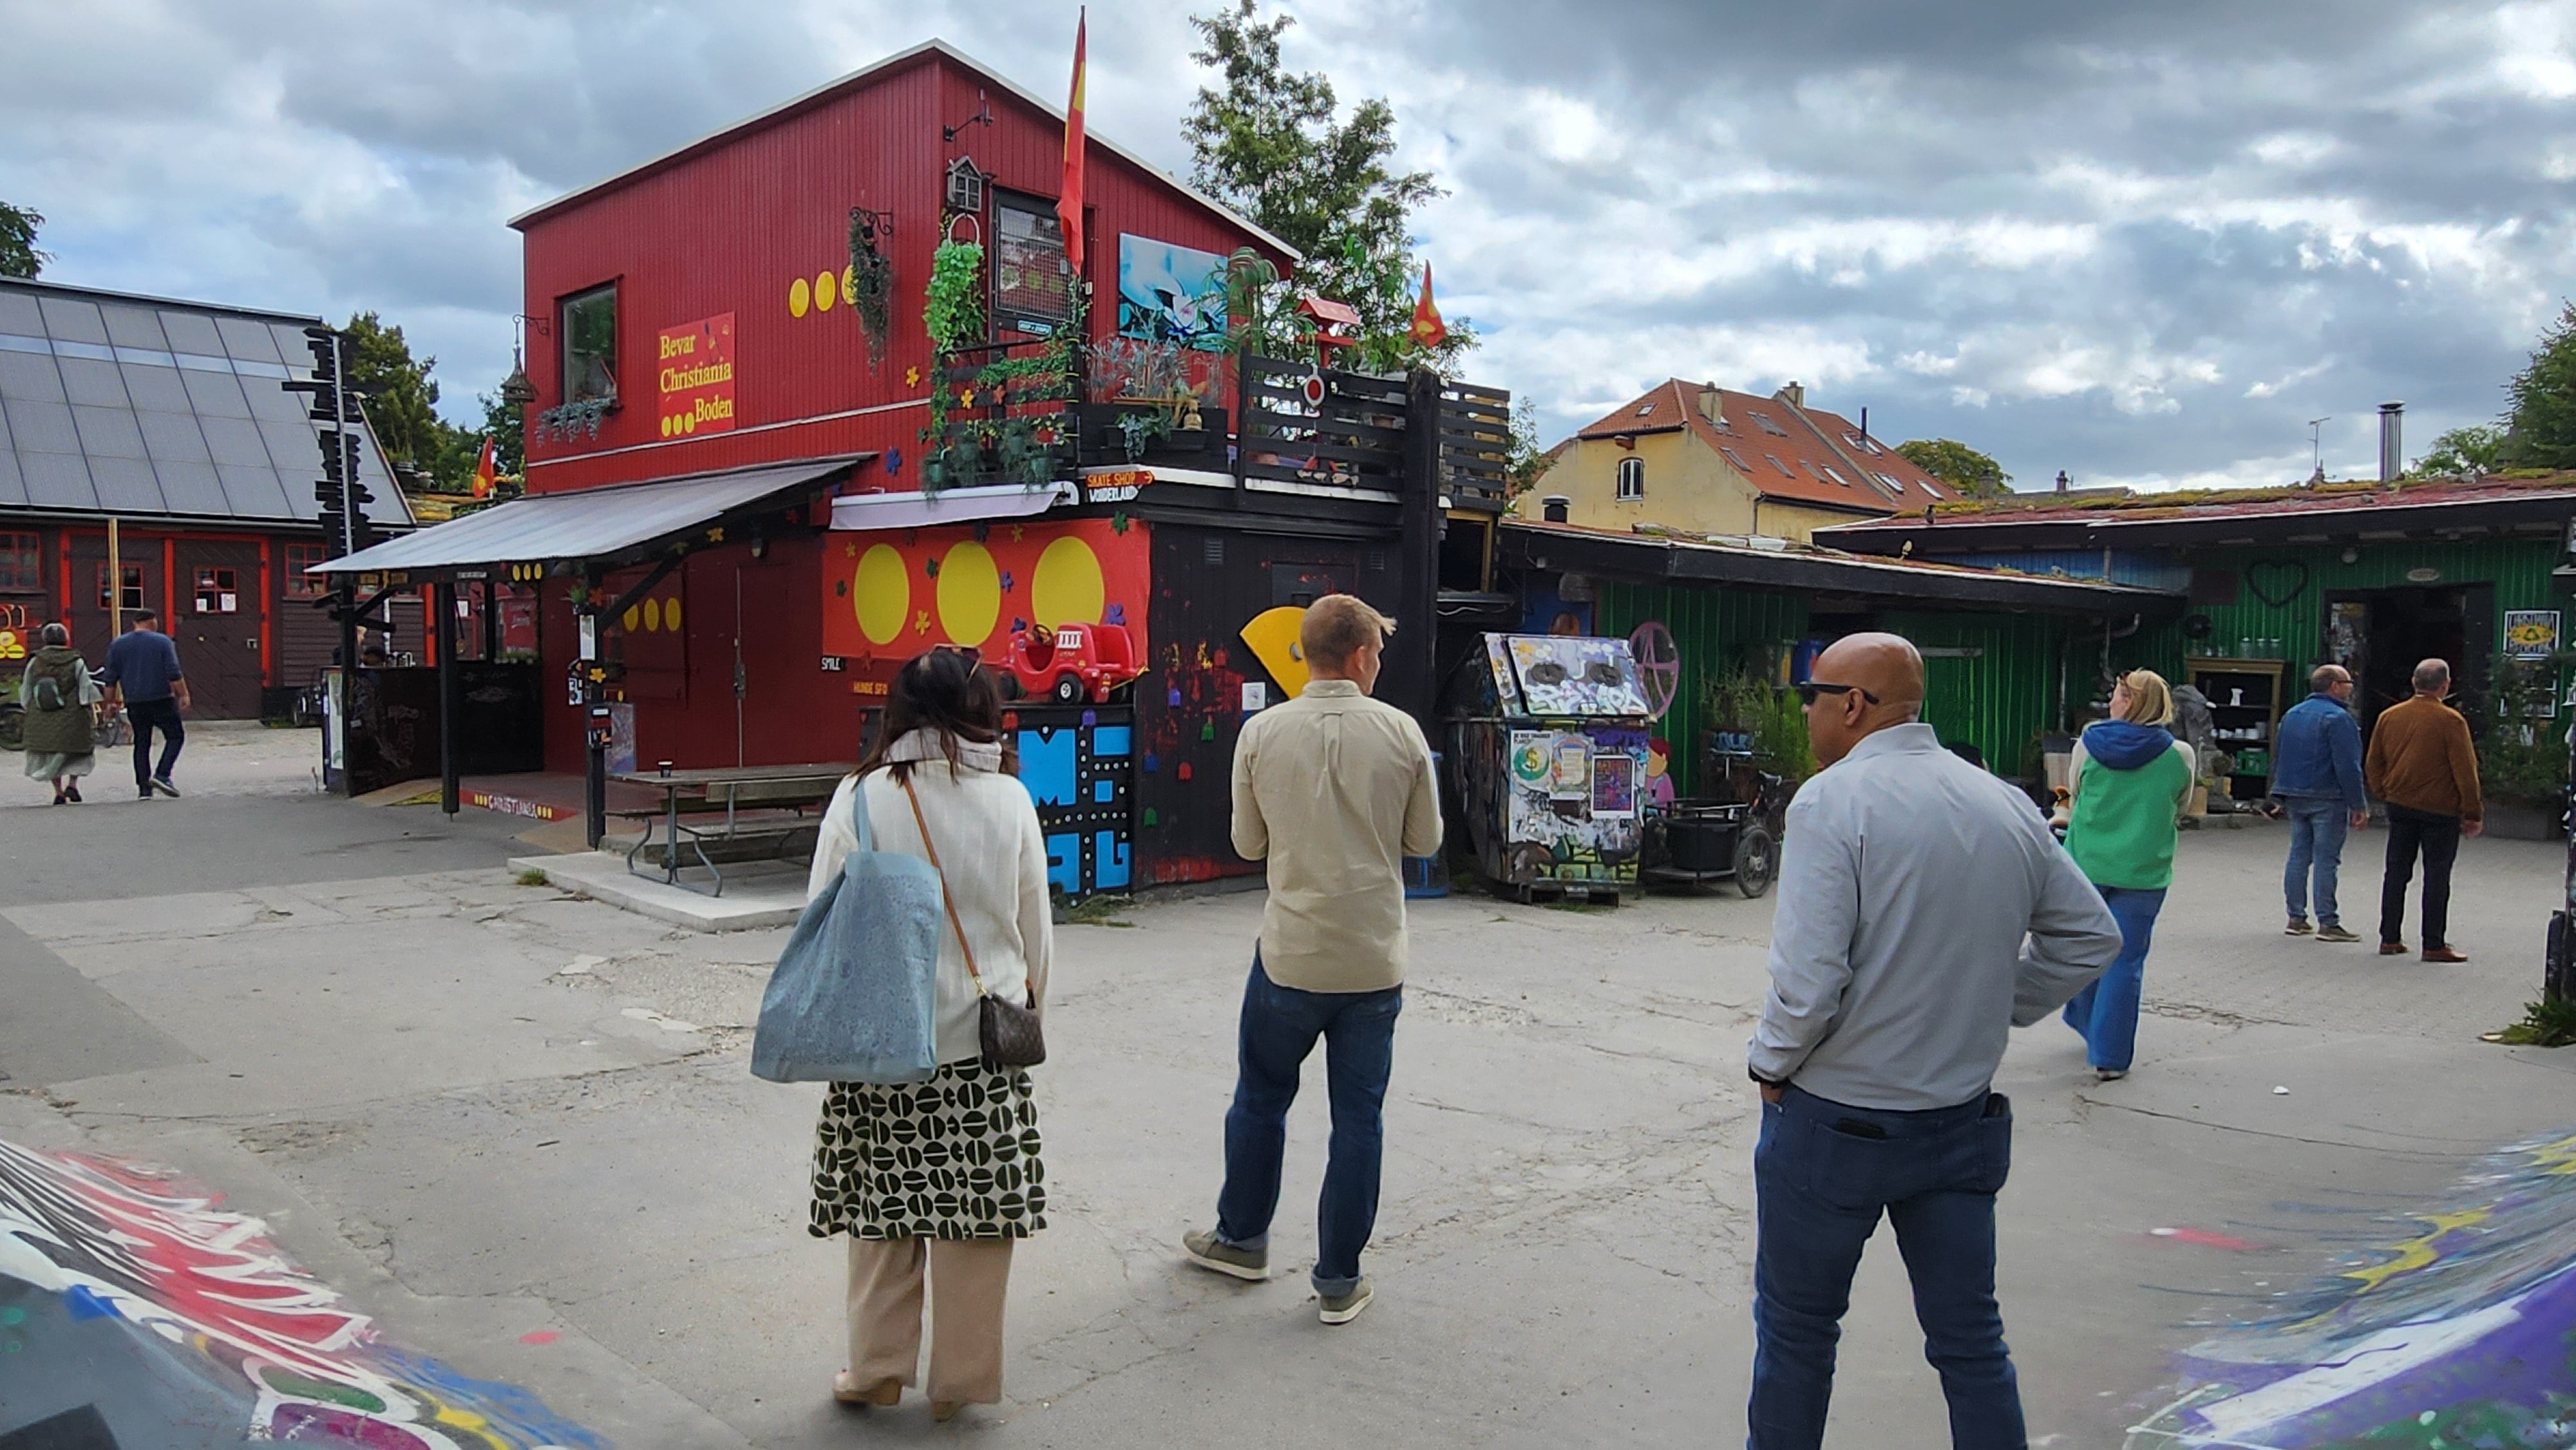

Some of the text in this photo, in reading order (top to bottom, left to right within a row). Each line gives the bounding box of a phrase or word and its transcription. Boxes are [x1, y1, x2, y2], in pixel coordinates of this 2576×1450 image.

[660, 334, 696, 359] Bevar
[661, 356, 732, 393] Christiania
[695, 393, 733, 423] Boden
[1087, 471, 1135, 487] SKATE SHOP
